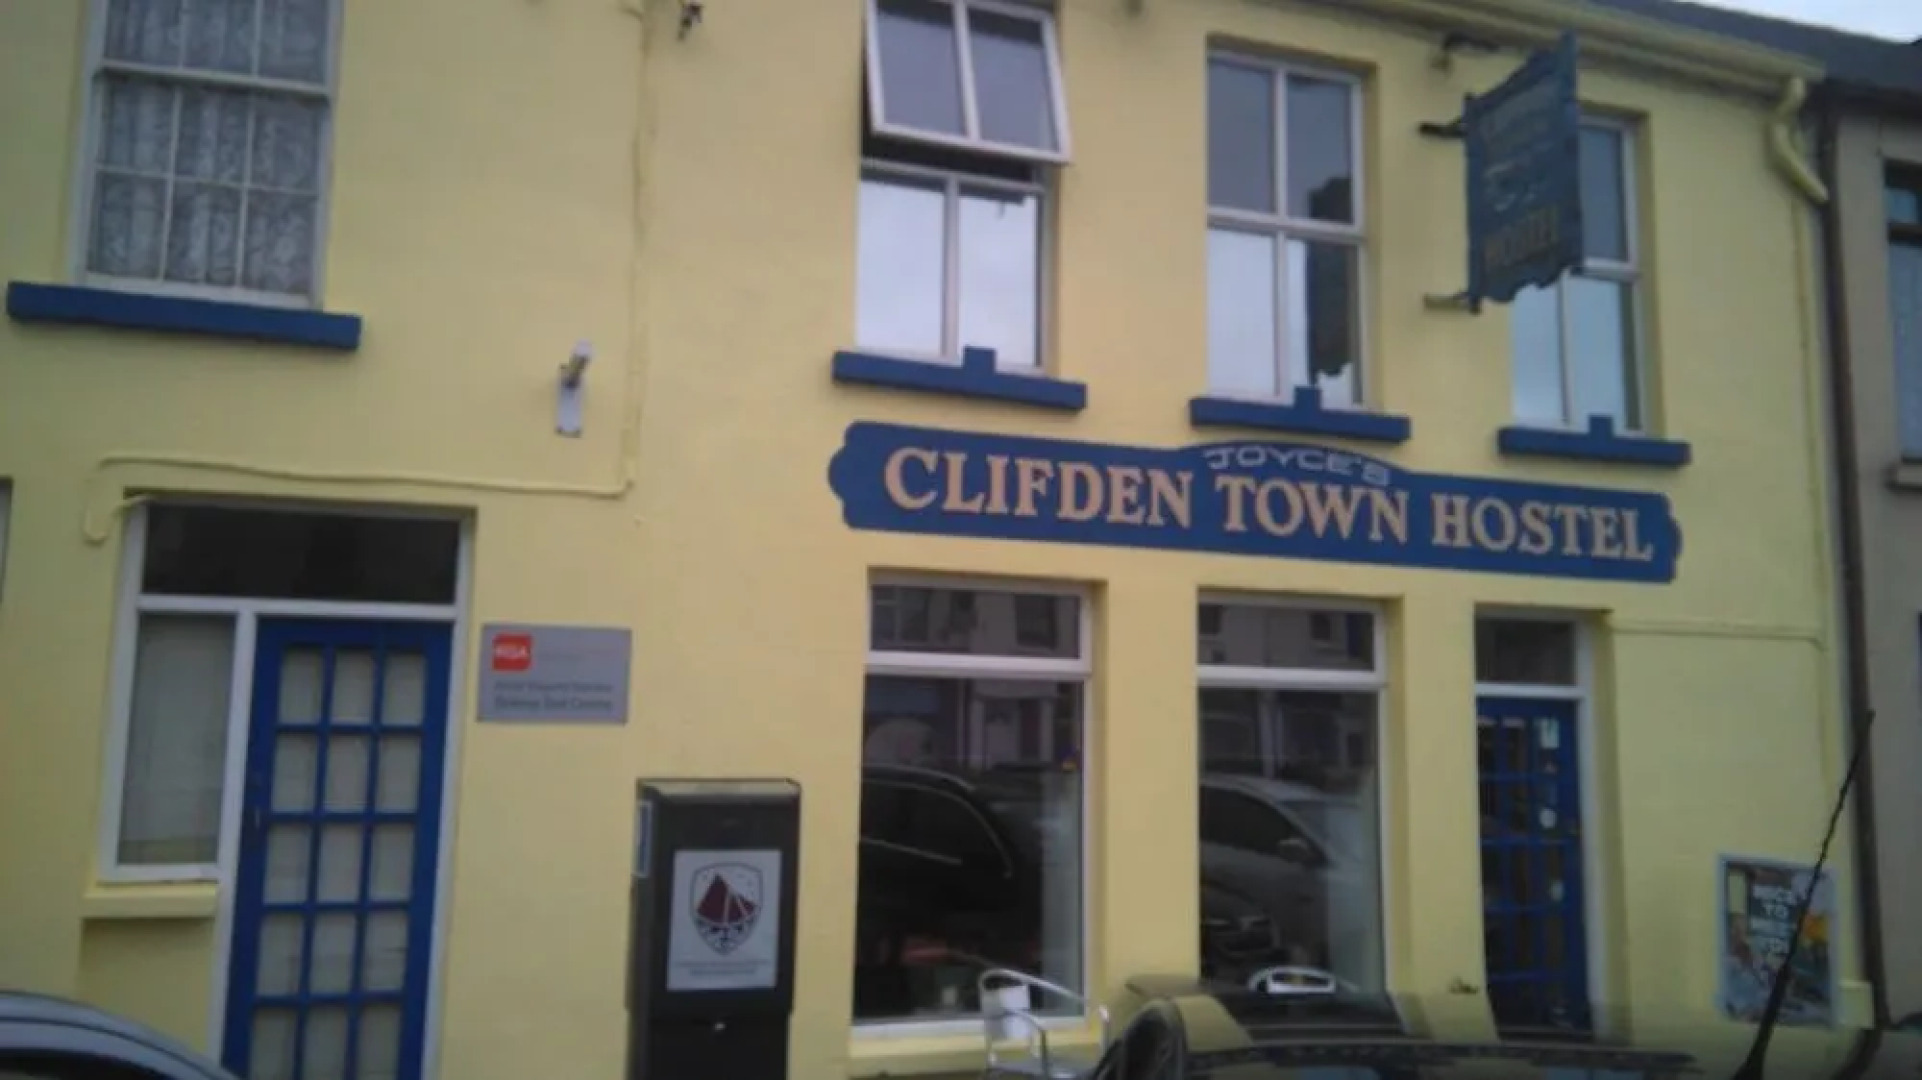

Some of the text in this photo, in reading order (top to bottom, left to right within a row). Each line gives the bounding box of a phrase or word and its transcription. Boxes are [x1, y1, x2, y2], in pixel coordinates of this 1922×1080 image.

[884, 447, 1654, 562] CLIFDEN TOWN HOSTEL
[1203, 445, 1390, 487] JOYCE'S
